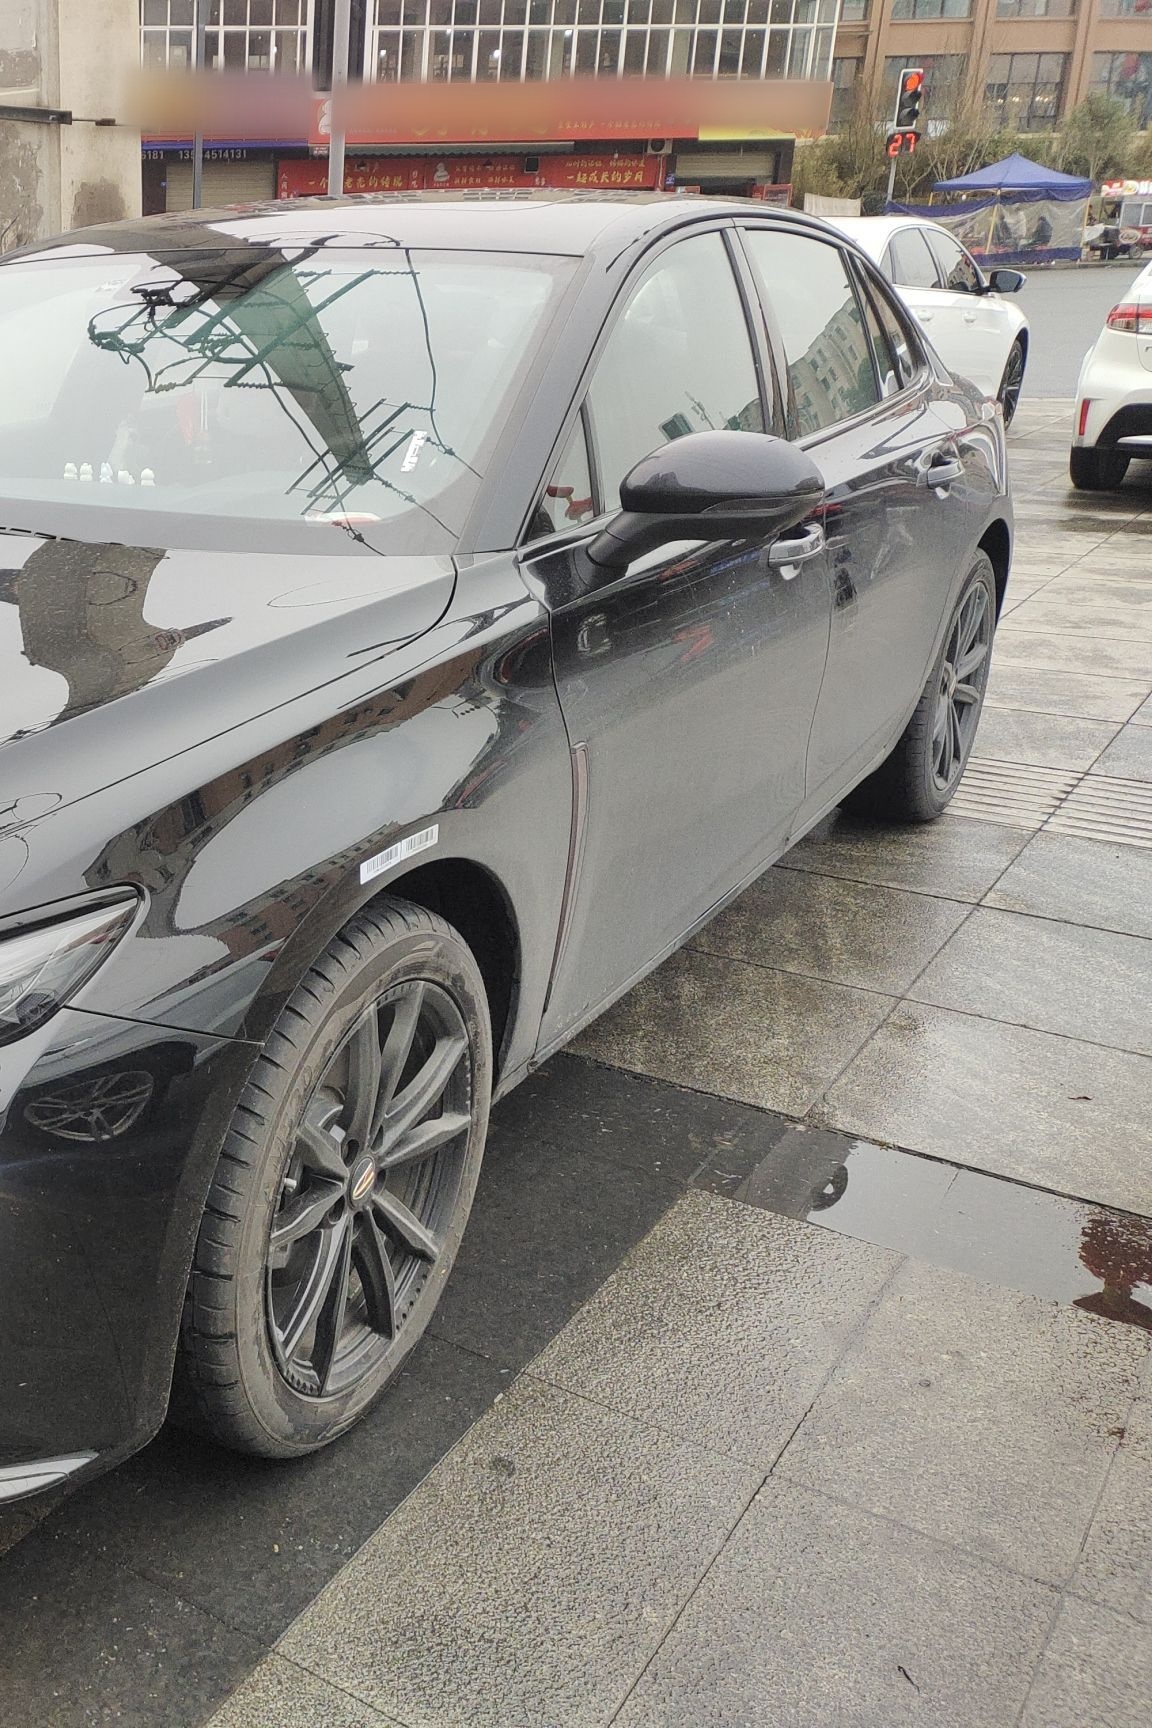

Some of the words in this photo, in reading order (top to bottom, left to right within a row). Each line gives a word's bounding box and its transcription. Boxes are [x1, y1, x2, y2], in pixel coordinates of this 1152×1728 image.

[888, 132, 915, 158] 27
[178, 149, 247, 160] 1354514131
[566, 170, 644, 184] 一起成长的岁月
